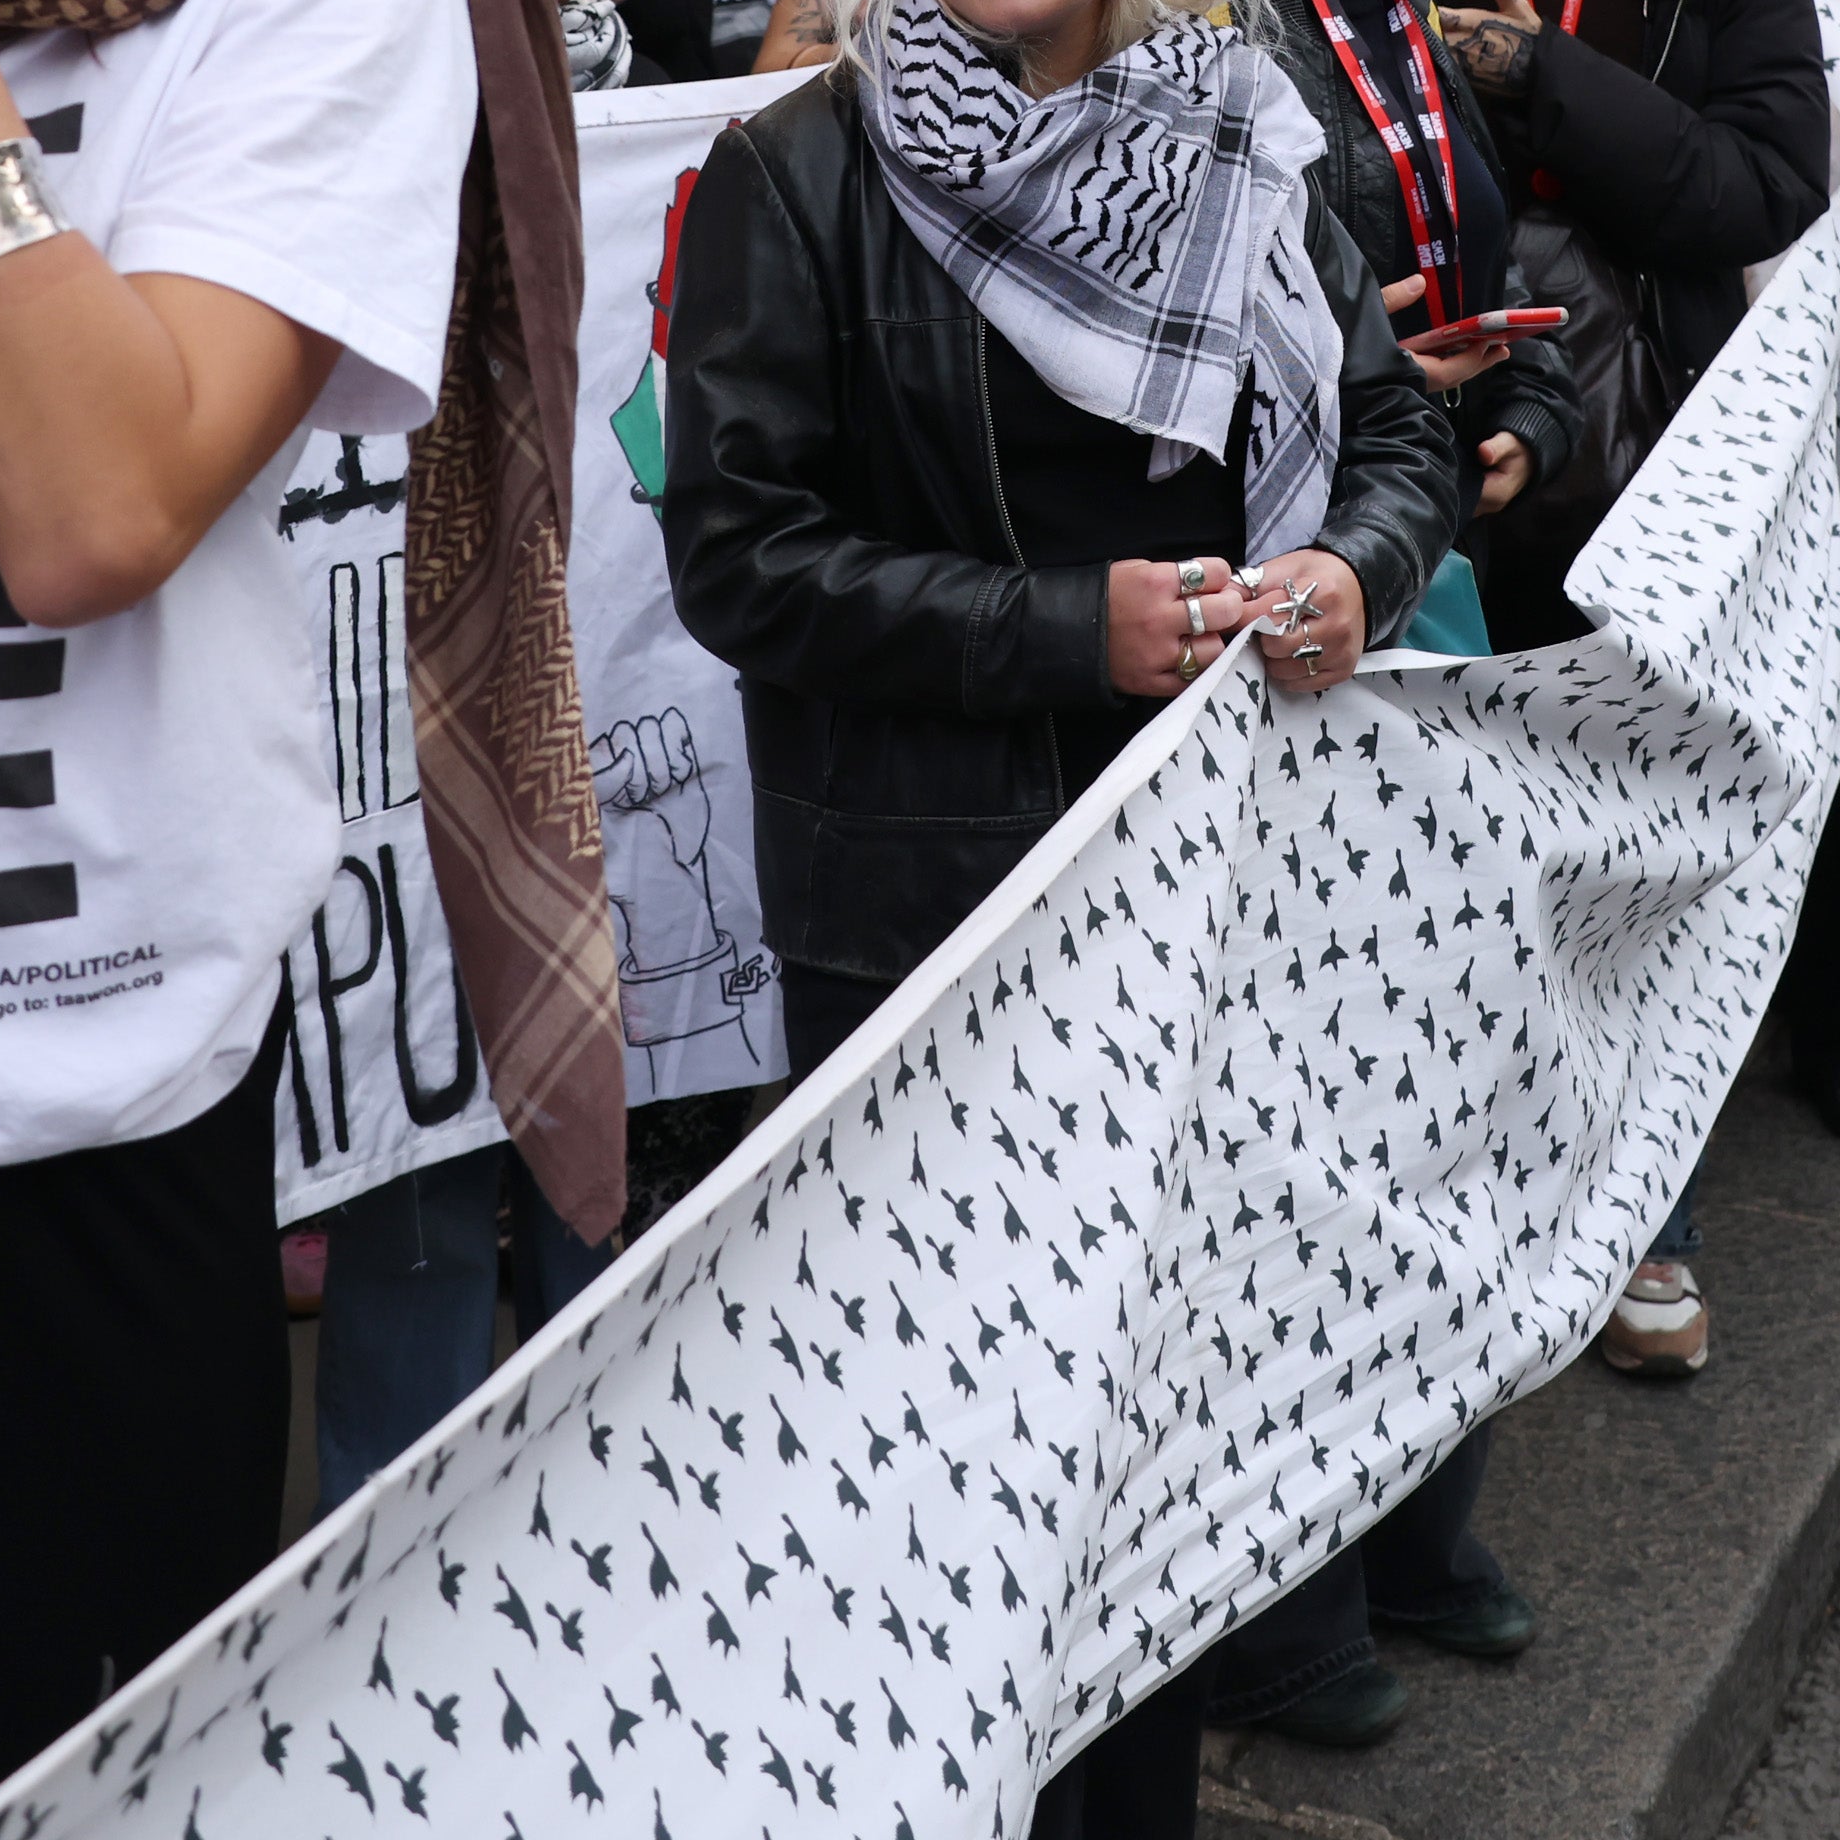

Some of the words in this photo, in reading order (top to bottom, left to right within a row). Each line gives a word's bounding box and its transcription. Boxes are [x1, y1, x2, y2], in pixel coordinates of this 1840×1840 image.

[1387, 7, 1403, 33] ROAR
[1396, 0, 1412, 27] NEWS
[1322, 17, 1344, 43] ROAR
[1334, 15, 1355, 40] NEWS
[1393, 121, 1414, 150] NEWS
[1418, 113, 1436, 140] ROAR
[1430, 111, 1445, 139] NEWS
[1380, 126, 1404, 153] ROAR
[1417, 244, 1435, 269] ROAR
[1431, 239, 1447, 266] NEWS
[24, 994, 49, 1013] to:
[55, 969, 165, 1008] taawon.org
